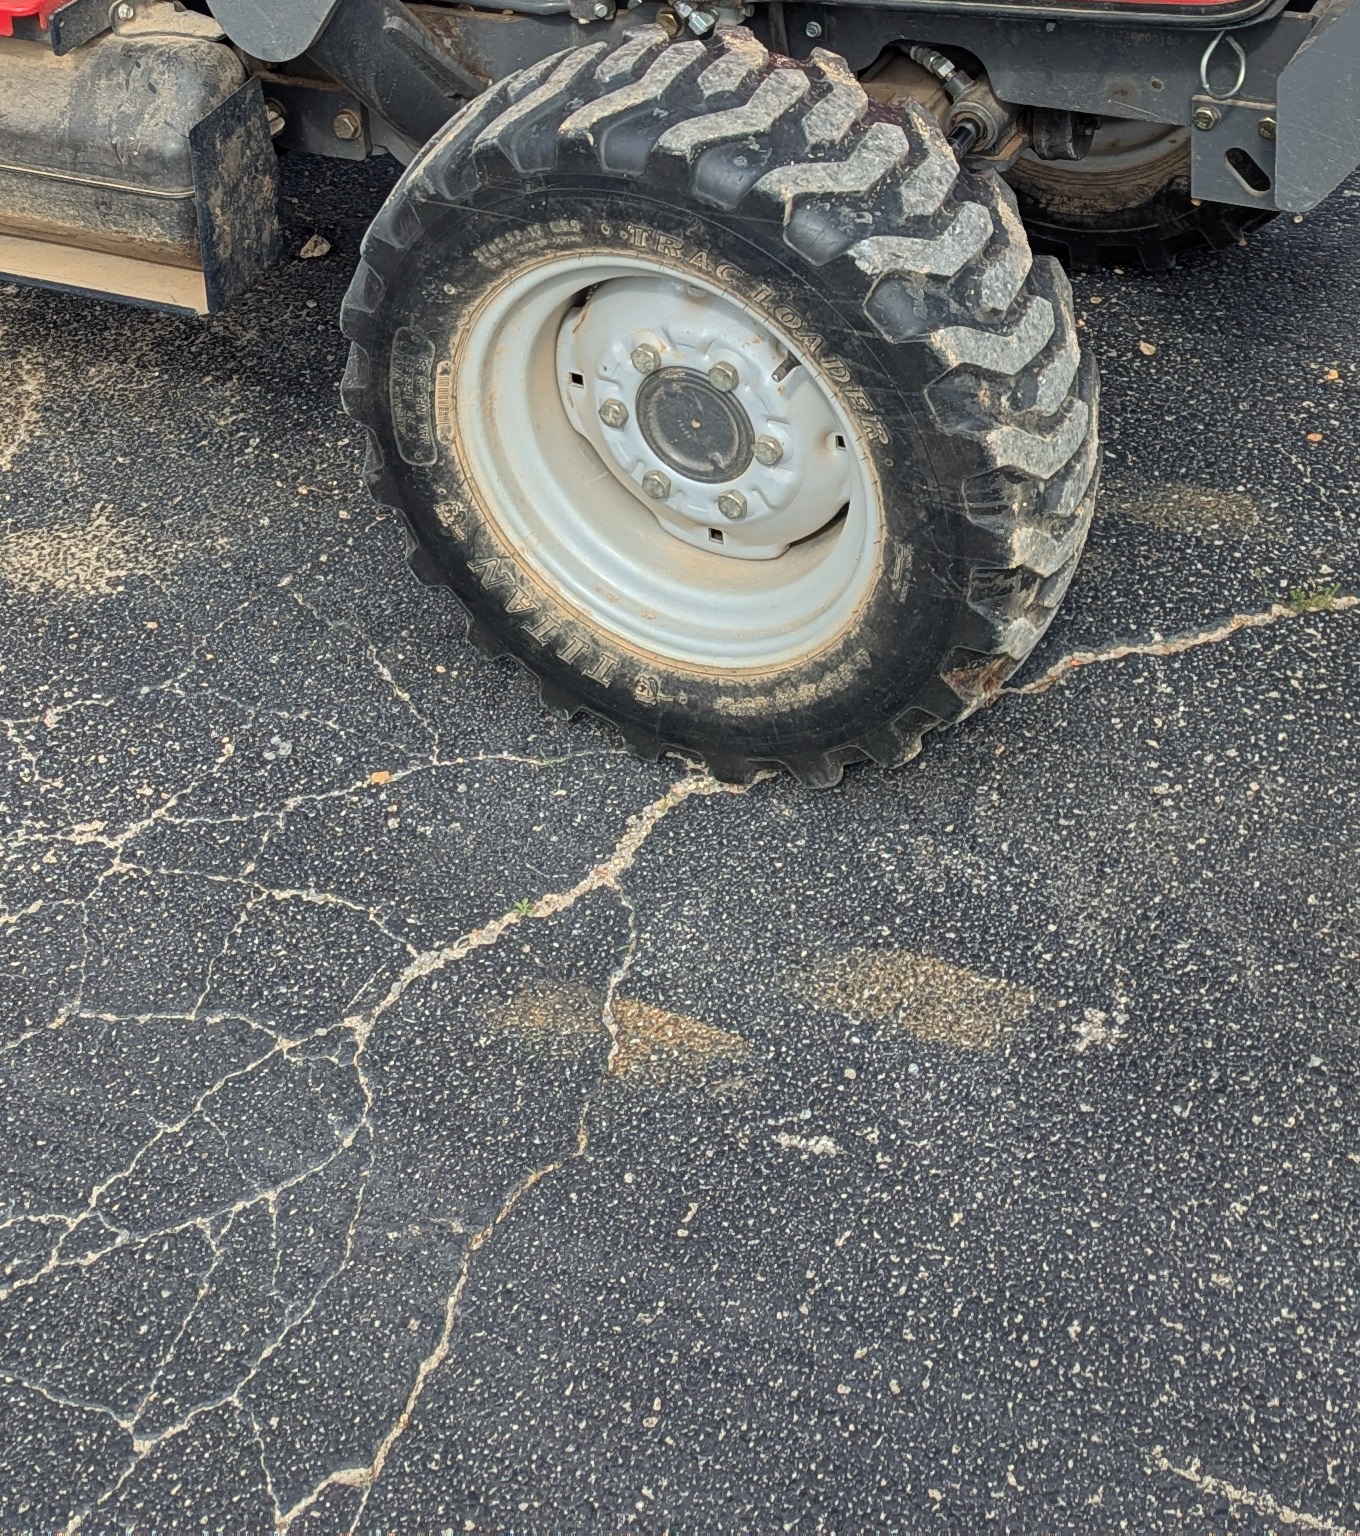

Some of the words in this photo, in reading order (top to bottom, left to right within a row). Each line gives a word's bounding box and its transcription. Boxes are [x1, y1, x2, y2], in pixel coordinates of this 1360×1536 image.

[627, 224, 745, 284] TRAC
[750, 284, 890, 445] LOADER
[467, 554, 620, 689] TITAN
